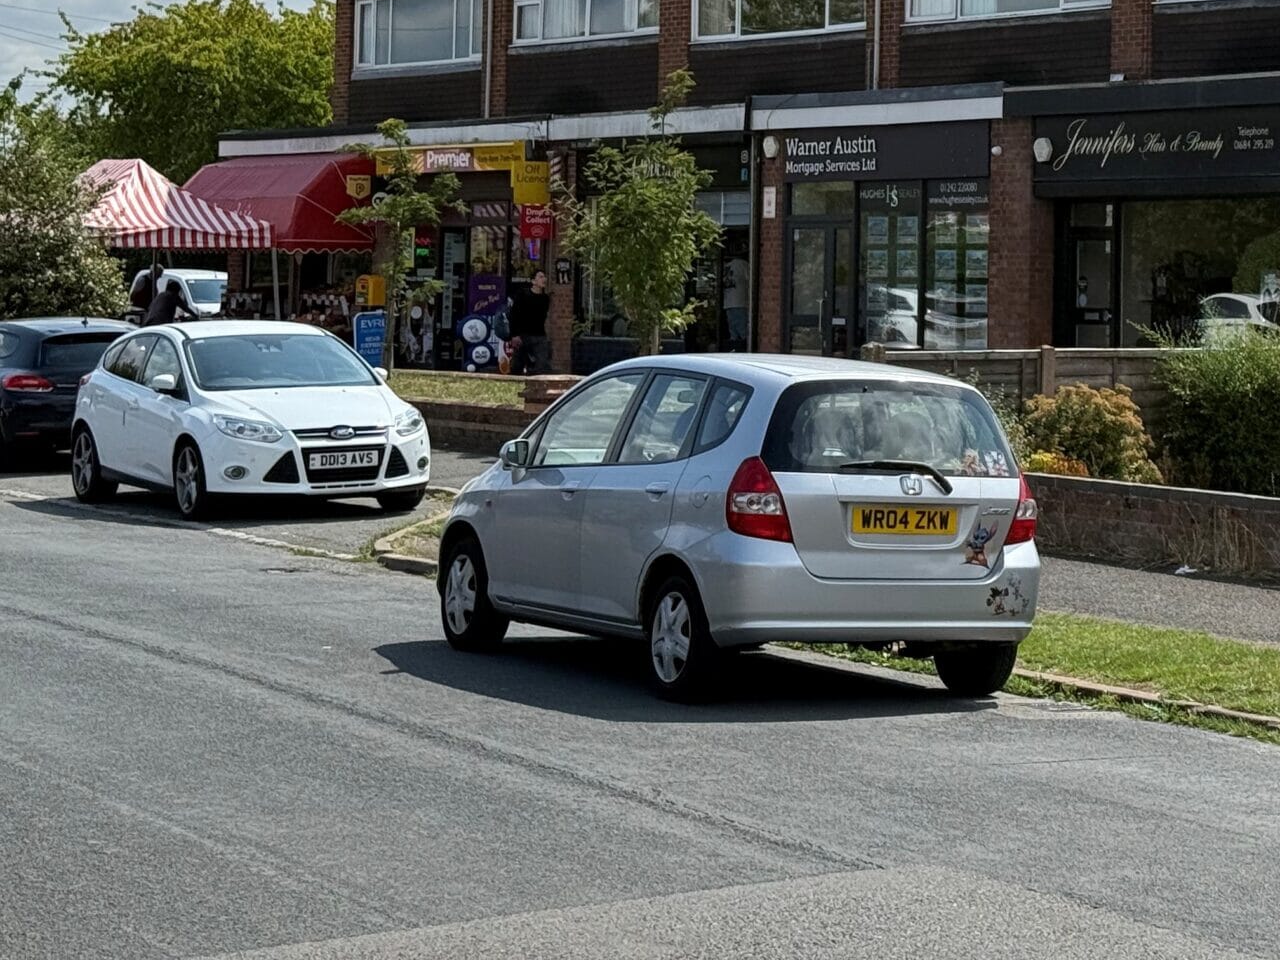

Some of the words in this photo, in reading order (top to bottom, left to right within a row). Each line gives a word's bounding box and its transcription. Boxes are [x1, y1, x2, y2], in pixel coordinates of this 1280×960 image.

[1238, 126, 1269, 138] Telephone
[785, 138, 831, 156] Warner
[834, 135, 876, 155] Austin
[1053, 119, 1135, 171] Jennifers
[1139, 133, 1165, 160] Hair
[1170, 134, 1179, 152] &
[1182, 130, 1223, 159] Beauty
[1233, 140, 1250, 150] 01684
[426, 150, 471, 168] Premier
[525, 164, 540, 174] Off
[785, 160, 824, 176] Mortgage
[826, 158, 860, 173] Services
[862, 158, 876, 171] Ltd
[517, 173, 550, 184] Licence
[860, 189, 885, 199] HUGHES
[320, 454, 347, 467] DD13
[351, 452, 373, 465] AVS
[862, 510, 910, 529] WR04
[915, 510, 949, 530] ZKW
